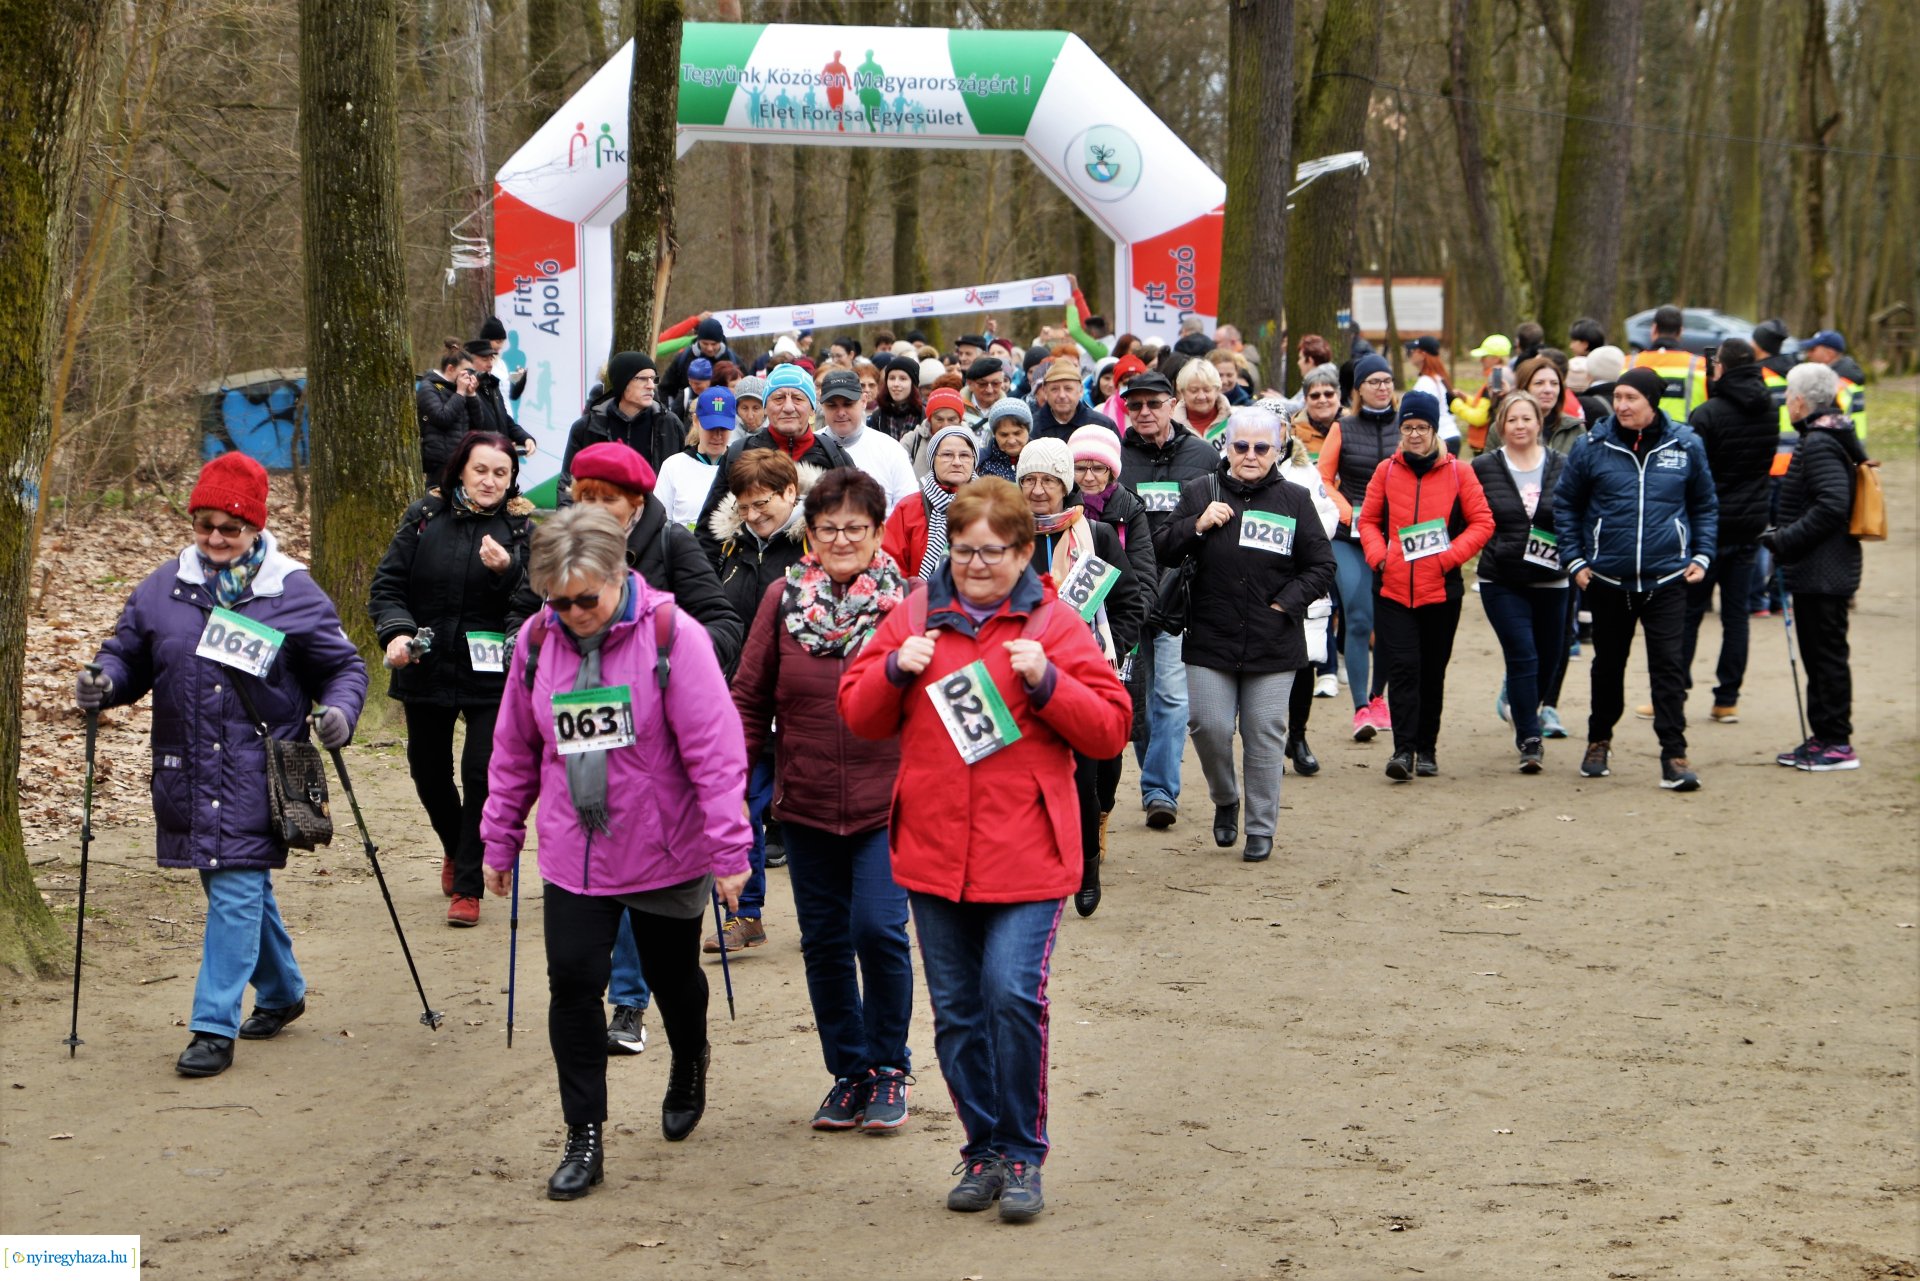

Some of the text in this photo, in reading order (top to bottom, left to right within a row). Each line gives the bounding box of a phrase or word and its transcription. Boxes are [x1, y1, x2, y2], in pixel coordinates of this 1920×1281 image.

[681, 64, 1031, 97] Tegyünk Közösen Magyarországért !
[760, 101, 795, 120] Élet
[870, 108, 963, 129] Egyesület
[513, 275, 533, 317] Fitt
[533, 259, 565, 336] Ápoló
[1144, 281, 1165, 324] Fitt
[1142, 492, 1179, 510] 025
[1243, 520, 1285, 545] 026
[1404, 530, 1441, 553] 073
[1529, 539, 1560, 562] 072
[1068, 559, 1106, 604] 049
[205, 623, 264, 661] 064
[472, 643, 503, 664] 01
[557, 706, 618, 741] 063
[943, 674, 995, 742] 023
